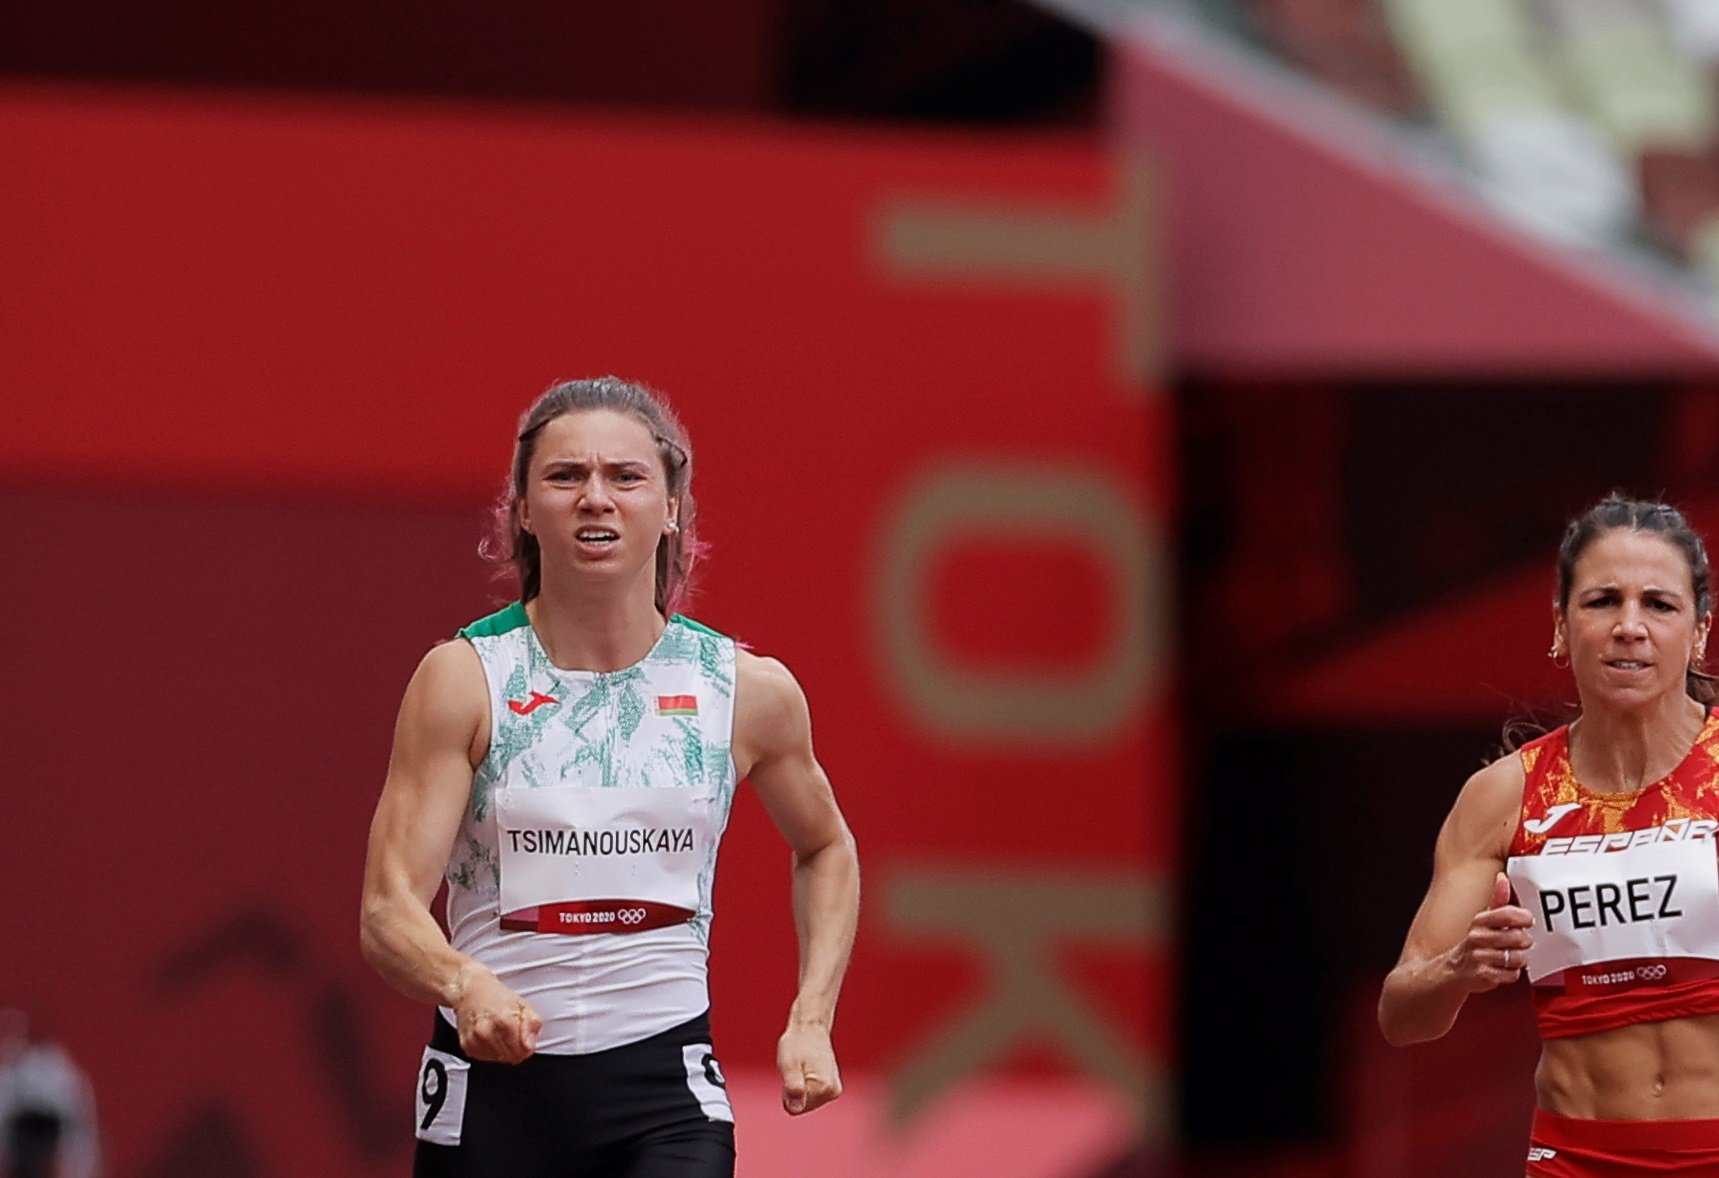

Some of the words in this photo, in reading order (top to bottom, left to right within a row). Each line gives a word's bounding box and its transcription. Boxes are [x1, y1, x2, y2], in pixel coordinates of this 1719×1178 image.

[507, 829, 694, 856] TSIMANOUSKAYA
[1539, 874, 1682, 933] PEREZ
[559, 912, 592, 923] TOKYO
[592, 912, 615, 923] 2020
[1582, 974, 1610, 985] TOKYO
[1610, 970, 1635, 983] 2020
[421, 1058, 448, 1131] 9
